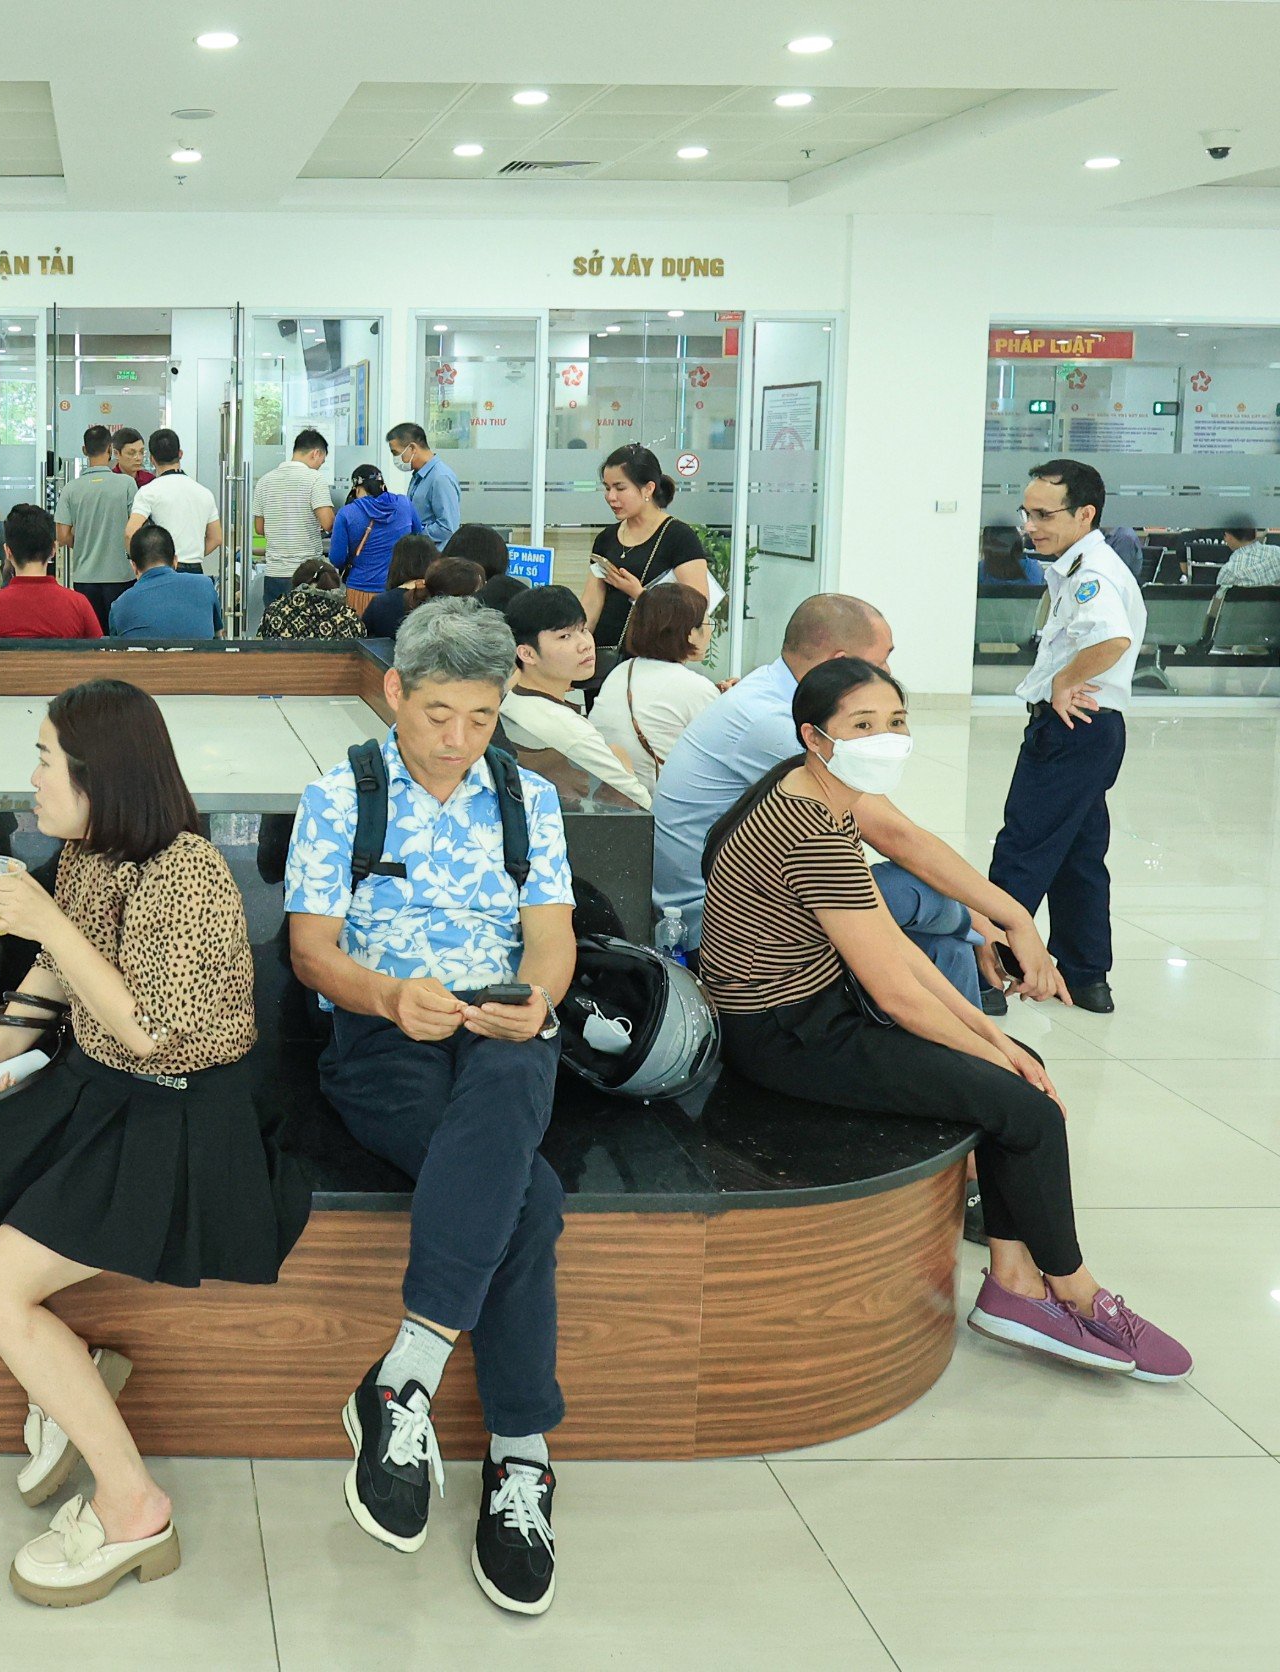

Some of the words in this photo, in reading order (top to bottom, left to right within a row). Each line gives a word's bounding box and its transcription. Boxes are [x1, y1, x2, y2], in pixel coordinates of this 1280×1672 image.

[38, 246, 74, 276] TẢI
[573, 249, 605, 276] SỞ
[610, 253, 654, 277] XÂY
[662, 256, 725, 281] DỰNG
[995, 335, 1045, 353] PHÁP
[508, 549, 520, 560] ẾP
[521, 551, 545, 563] HÀNG
[509, 563, 524, 575] LẤY
[526, 565, 538, 577] SỐ
